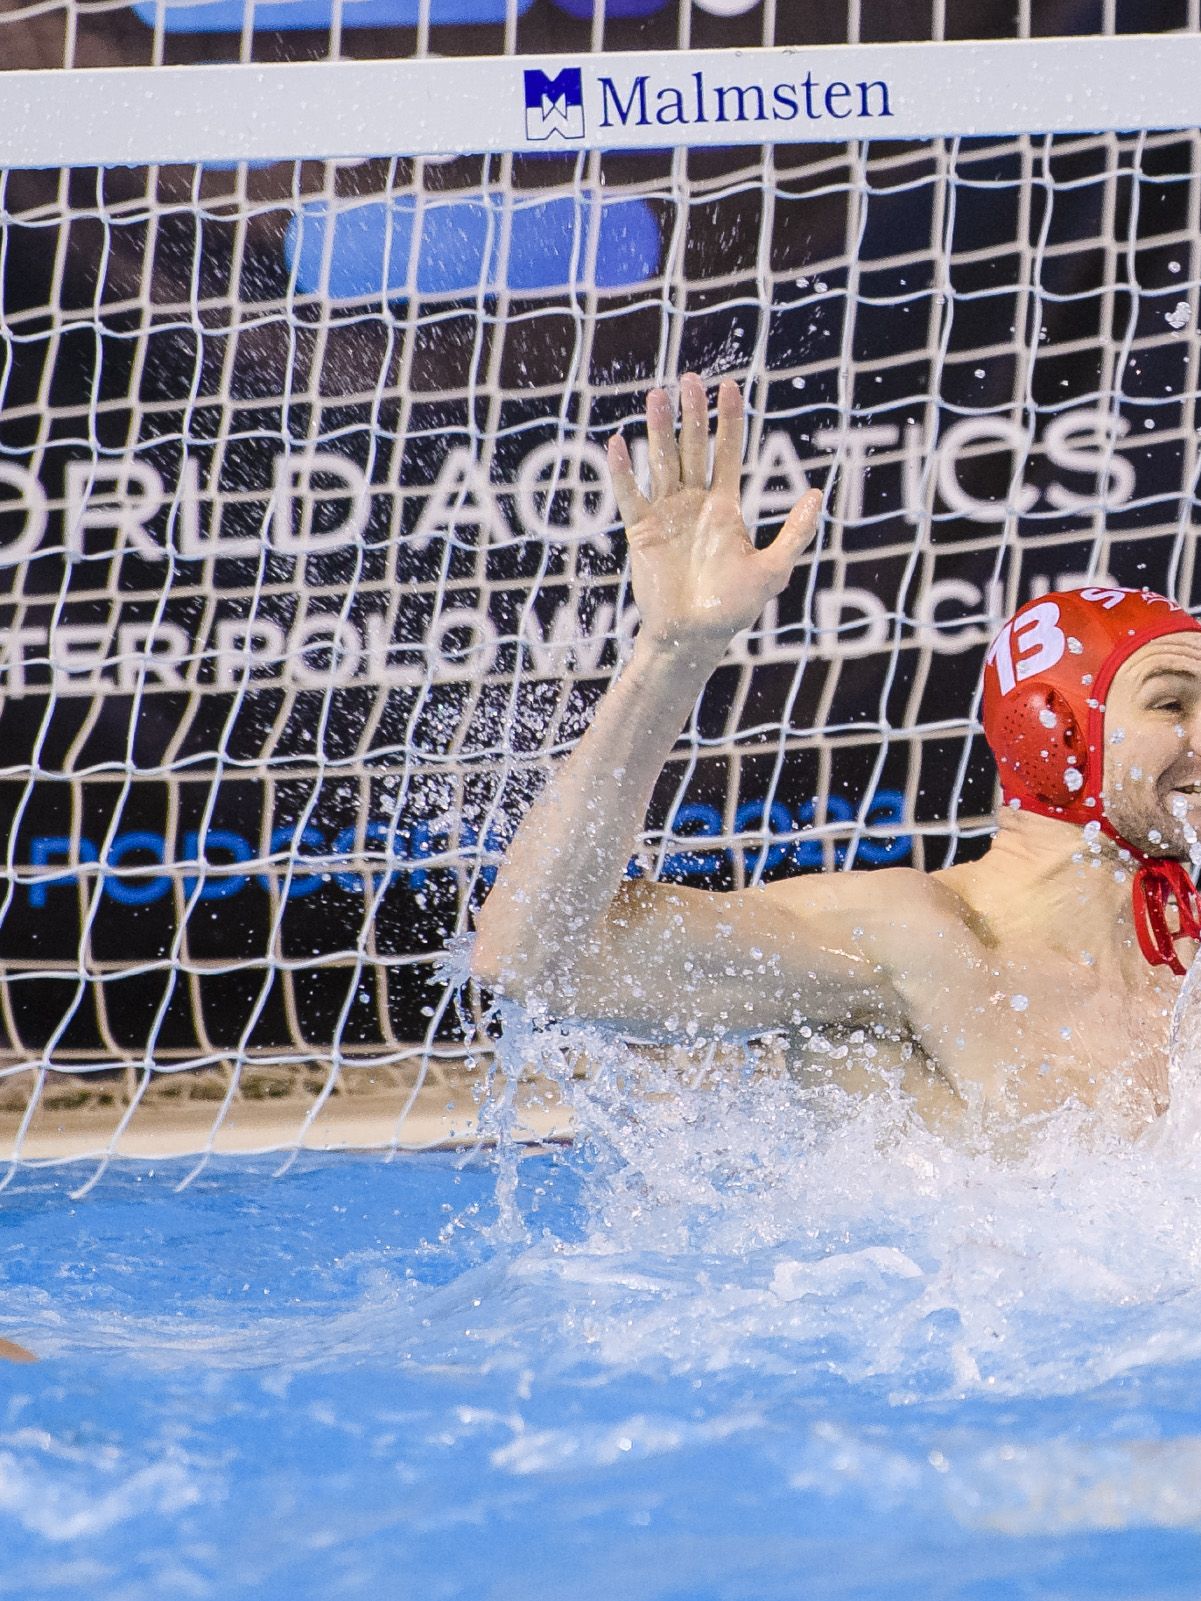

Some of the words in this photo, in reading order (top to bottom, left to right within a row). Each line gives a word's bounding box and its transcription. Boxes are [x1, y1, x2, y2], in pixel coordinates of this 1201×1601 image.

[598, 71, 895, 127] Malmsten
[217, 607, 500, 690] POLO
[516, 586, 890, 675] WLD
[988, 602, 1066, 696] 13
